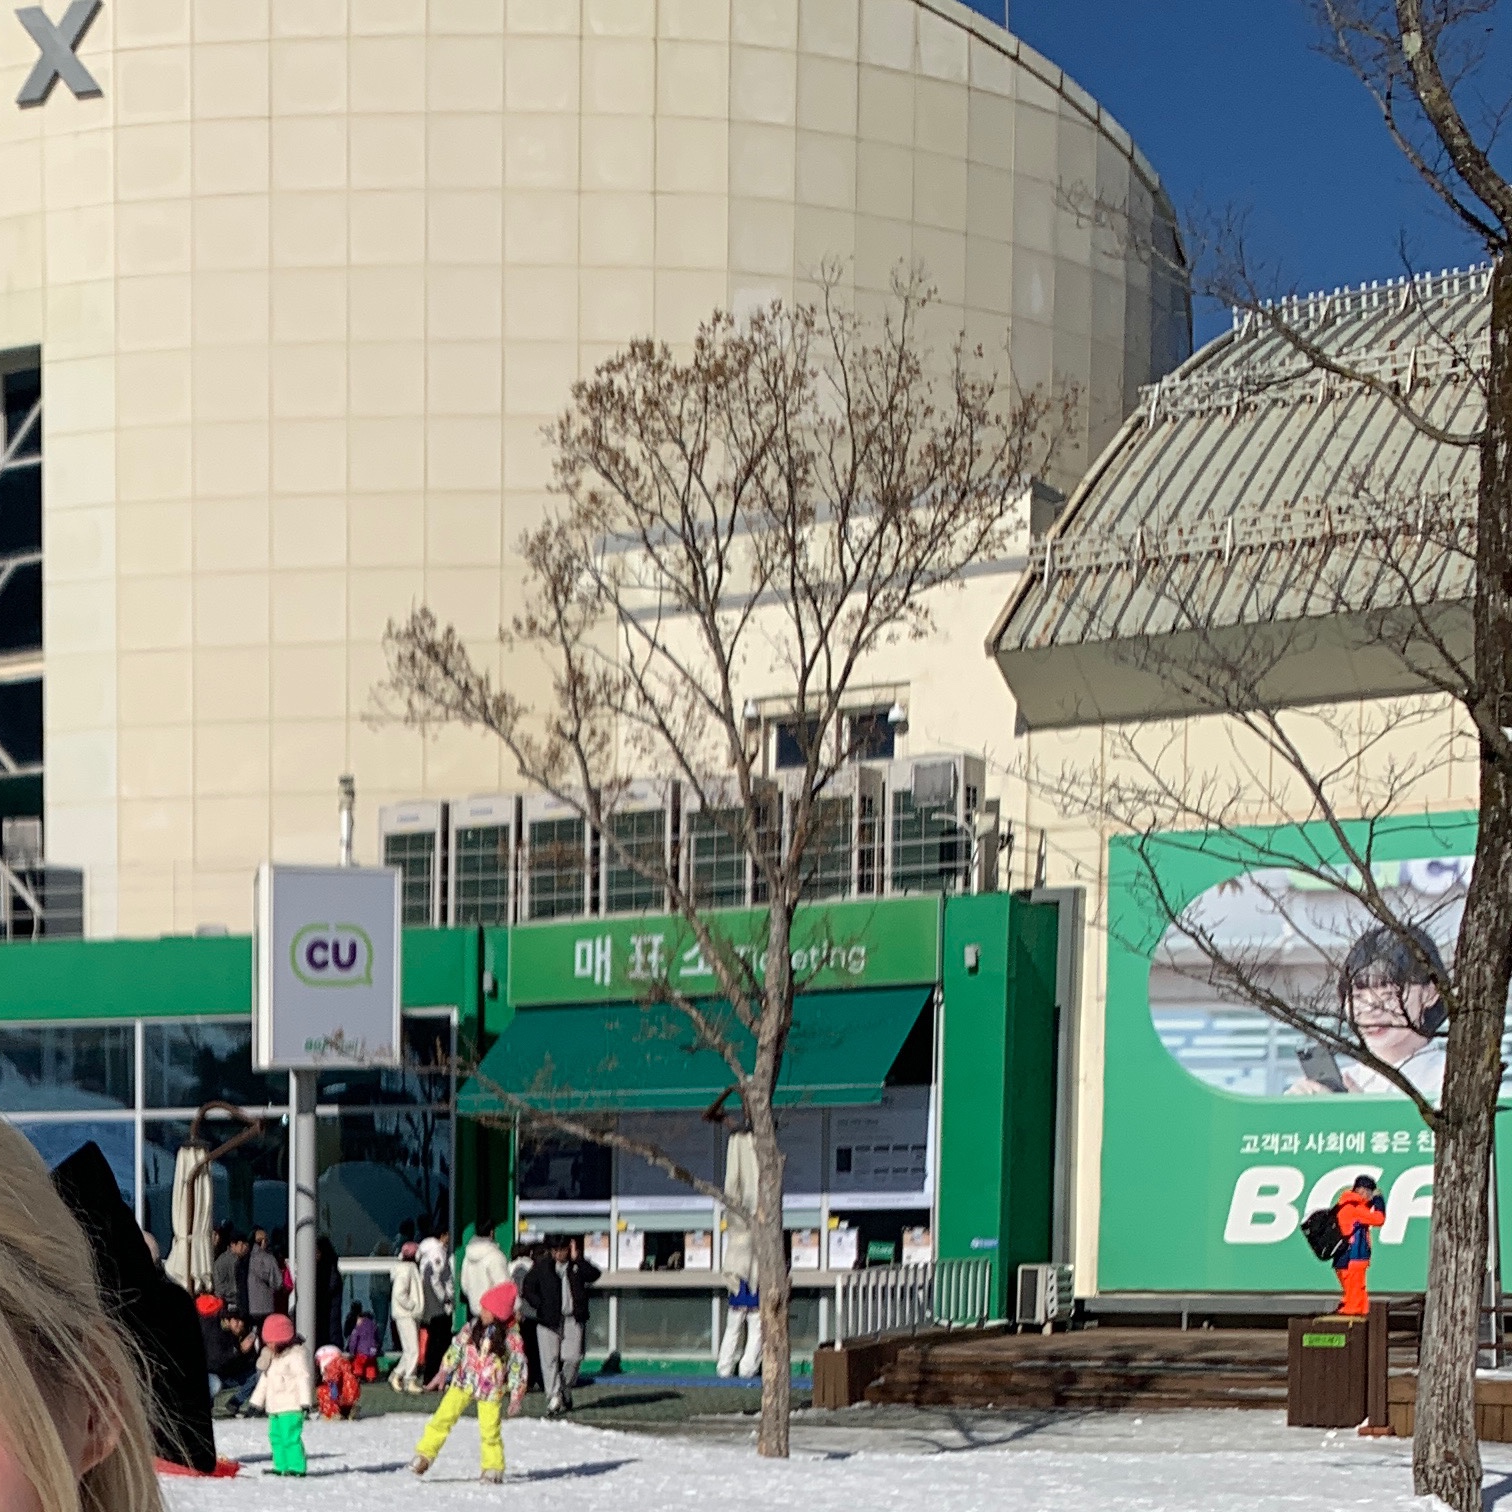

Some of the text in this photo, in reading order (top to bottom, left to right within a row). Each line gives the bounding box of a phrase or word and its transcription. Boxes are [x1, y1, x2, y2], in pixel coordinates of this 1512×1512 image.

[305, 937, 357, 972] CU
[1239, 1133, 1301, 1155] 고객과
[1305, 1131, 1366, 1154] 사회에
